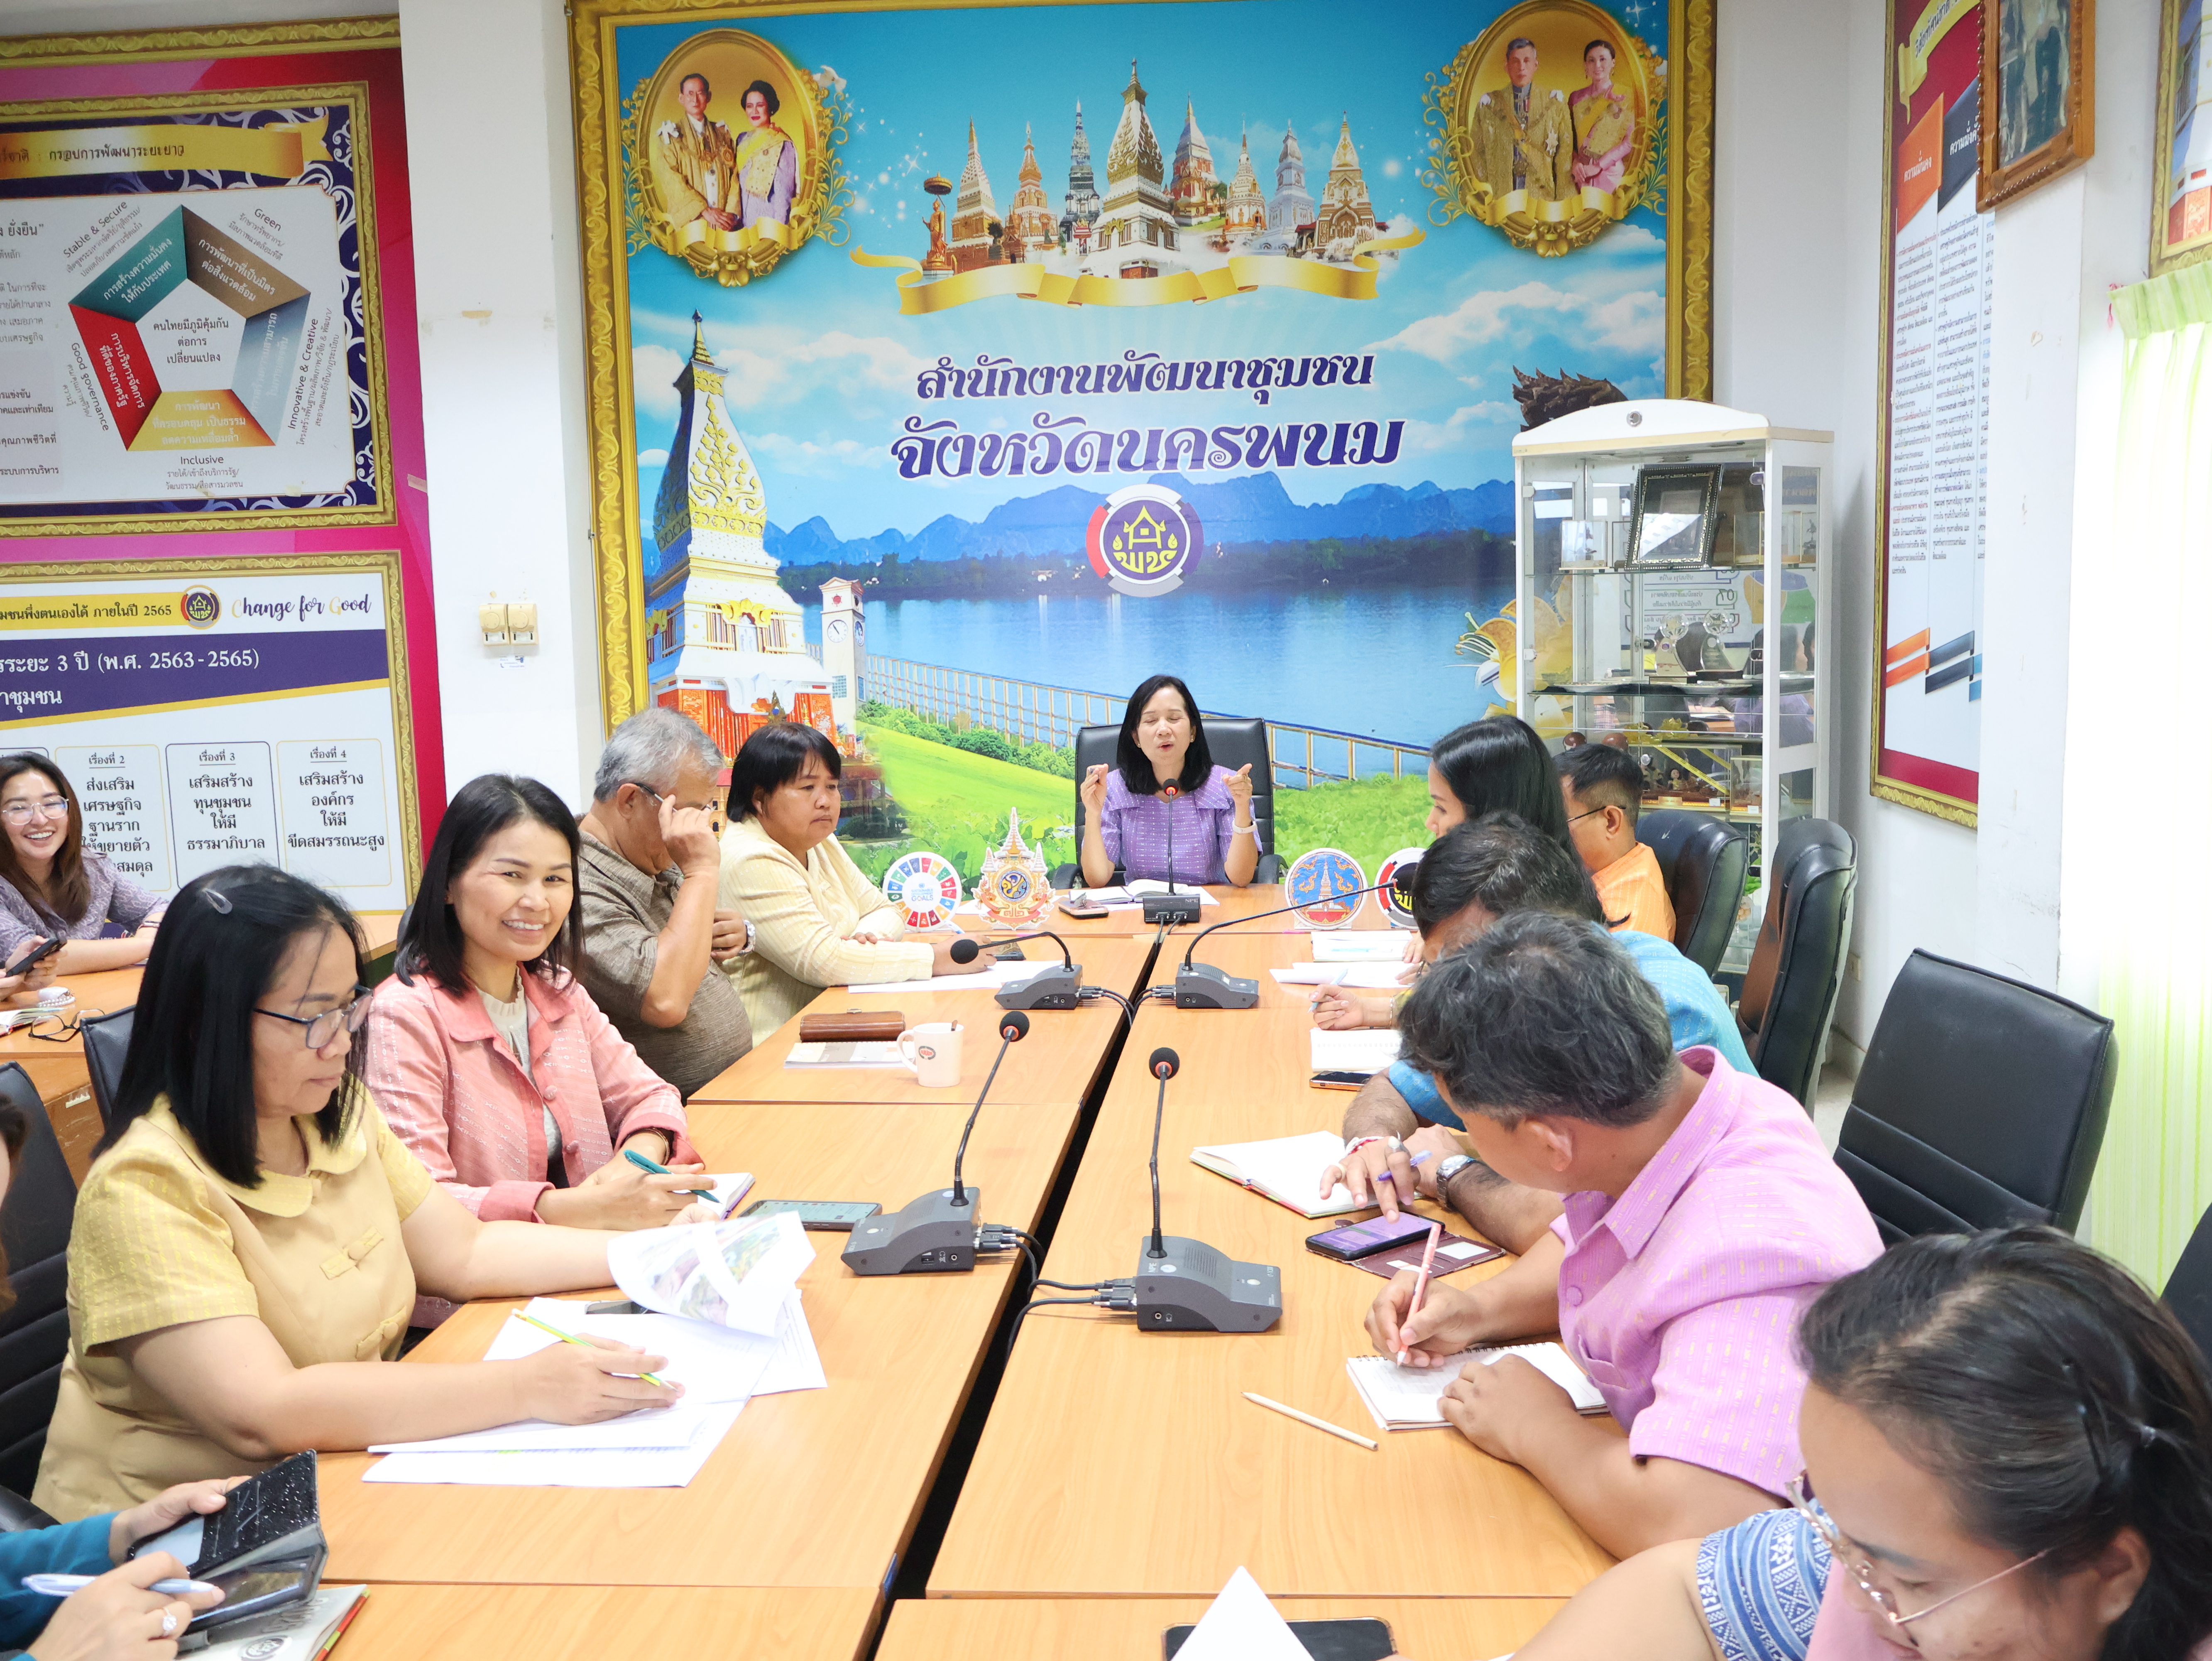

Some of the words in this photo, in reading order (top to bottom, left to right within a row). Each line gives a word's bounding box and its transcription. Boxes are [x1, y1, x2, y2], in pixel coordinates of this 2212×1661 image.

[49, 144, 184, 161] กรอบการพัฒนาระยะยาว
[1904, 150, 1933, 183] ความมั่นคง
[254, 208, 281, 231] Green
[64, 233, 91, 258] Stable
[91, 225, 100, 234] &
[99, 201, 127, 228] Secure
[104, 237, 172, 300] การสร้างความมั่นคง
[198, 239, 275, 295] การพัฒนาที่เป็นมิตร
[121, 260, 171, 303] ให้กับประเทศ
[202, 260, 256, 301] ต่อสิ่งแวดล้อม
[153, 316, 229, 333] คนไทยมีภูมิคุ้มกัน
[178, 338, 207, 347] ต่อการ
[167, 350, 220, 364] เปลี่ยนแปลง
[99, 345, 128, 408] ที่ดีของภาครัฐ
[111, 333, 145, 409] การบริหารจัดการ
[288, 376, 306, 429] Innovative
[303, 318, 318, 361] Creative
[918, 351, 1374, 404] สำนักงานพัฒนาชุมชน
[71, 343, 87, 370] Good
[81, 374, 109, 431] governance
[62, 385, 76, 407] ความรู้
[207, 415, 246, 427] เป็นธรรม
[892, 414, 1405, 477] จังหวัดนครพนม
[180, 456, 224, 465] Inclusive
[93, 602, 138, 617] ภายในปี
[144, 605, 171, 616] 2565
[232, 597, 295, 621] Change
[299, 595, 325, 622] for
[329, 594, 372, 615] Good
[57, 655, 68, 671] 3
[73, 650, 89, 671] ปี
[98, 652, 142, 674] (พ.ศ.
[89, 752, 115, 764] เรื่องที่
[120, 755, 125, 764] 2
[199, 749, 225, 762] เรื่องที่
[230, 753, 235, 761] 3
[310, 746, 337, 759] เรื่องที่
[341, 750, 347, 758] 4
[87, 777, 135, 791] ส่งเสริม
[189, 773, 253, 788] เสริมสร้าง
[299, 770, 364, 786] เสริมสร้าง
[83, 797, 141, 815] เศรษฐกิจ
[193, 797, 252, 814] ทุนชุมชน
[311, 791, 354, 806] องค์กร
[210, 812, 237, 829] ให้มี
[321, 810, 347, 826] ให้มี
[89, 821, 140, 836] ฐานราก
[187, 835, 265, 850] ธรรมาภิบาล
[288, 833, 384, 851] ขีดสมรรถนะสูง
[113, 860, 153, 877] สมดุล
[1148, 1262, 1157, 1273] NPE
